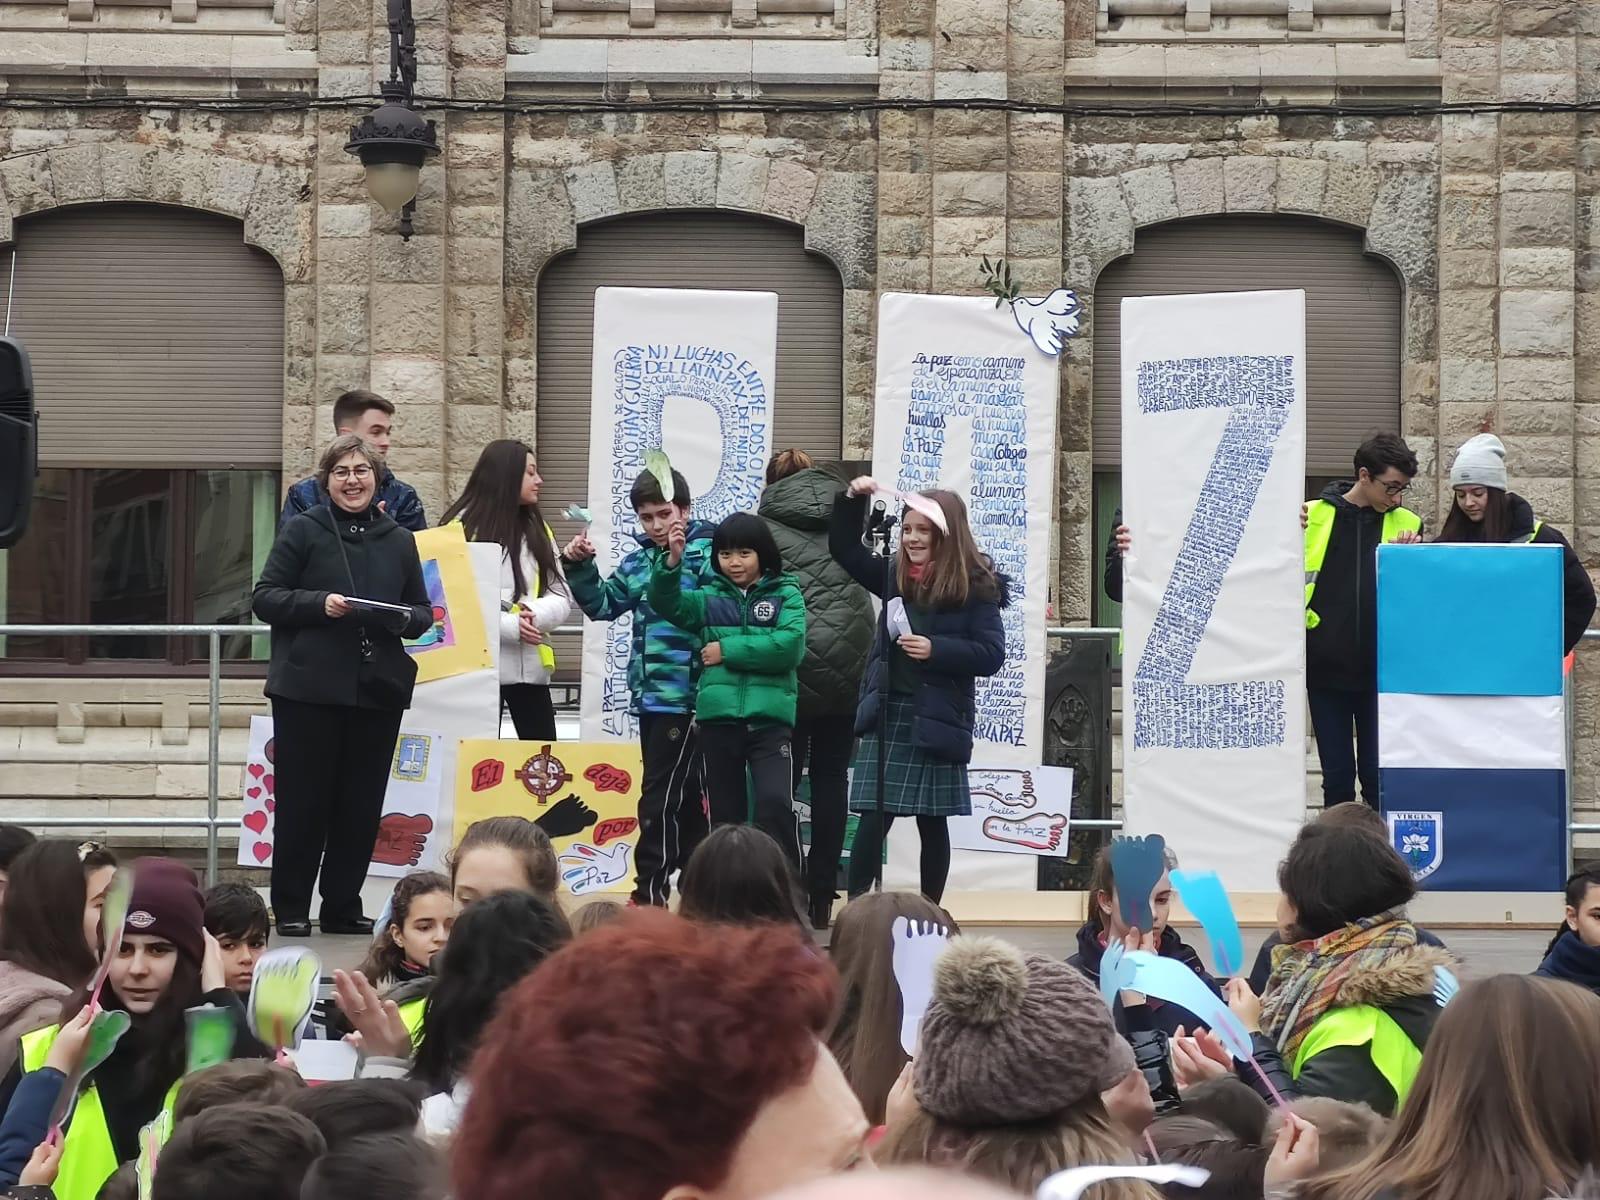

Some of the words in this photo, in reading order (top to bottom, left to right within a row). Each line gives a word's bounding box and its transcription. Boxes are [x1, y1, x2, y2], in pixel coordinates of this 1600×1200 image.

[912, 353, 930, 364] La
[929, 355, 953, 372] paz
[953, 355, 982, 369] como
[982, 355, 1027, 370] camino
[623, 346, 645, 405] GUERRA
[648, 344, 668, 360] NI
[673, 344, 737, 370] LUCHAS
[736, 359, 767, 417] ENTRE
[935, 366, 1006, 385] esperanza
[645, 360, 679, 374] DEL
[736, 405, 751, 473] DEFINIDA
[908, 408, 946, 429] huellas
[611, 460, 625, 527] SONRISA
[970, 481, 1027, 501] alumnos
[757, 606, 770, 617] 65
[602, 677, 613, 712] PAZ
[999, 724, 1027, 747] PAZ
[476, 763, 499, 788] El
[586, 765, 632, 792] deja
[599, 819, 634, 842] por
[1015, 821, 1047, 838] PAZ
[585, 866, 610, 887] Paz
